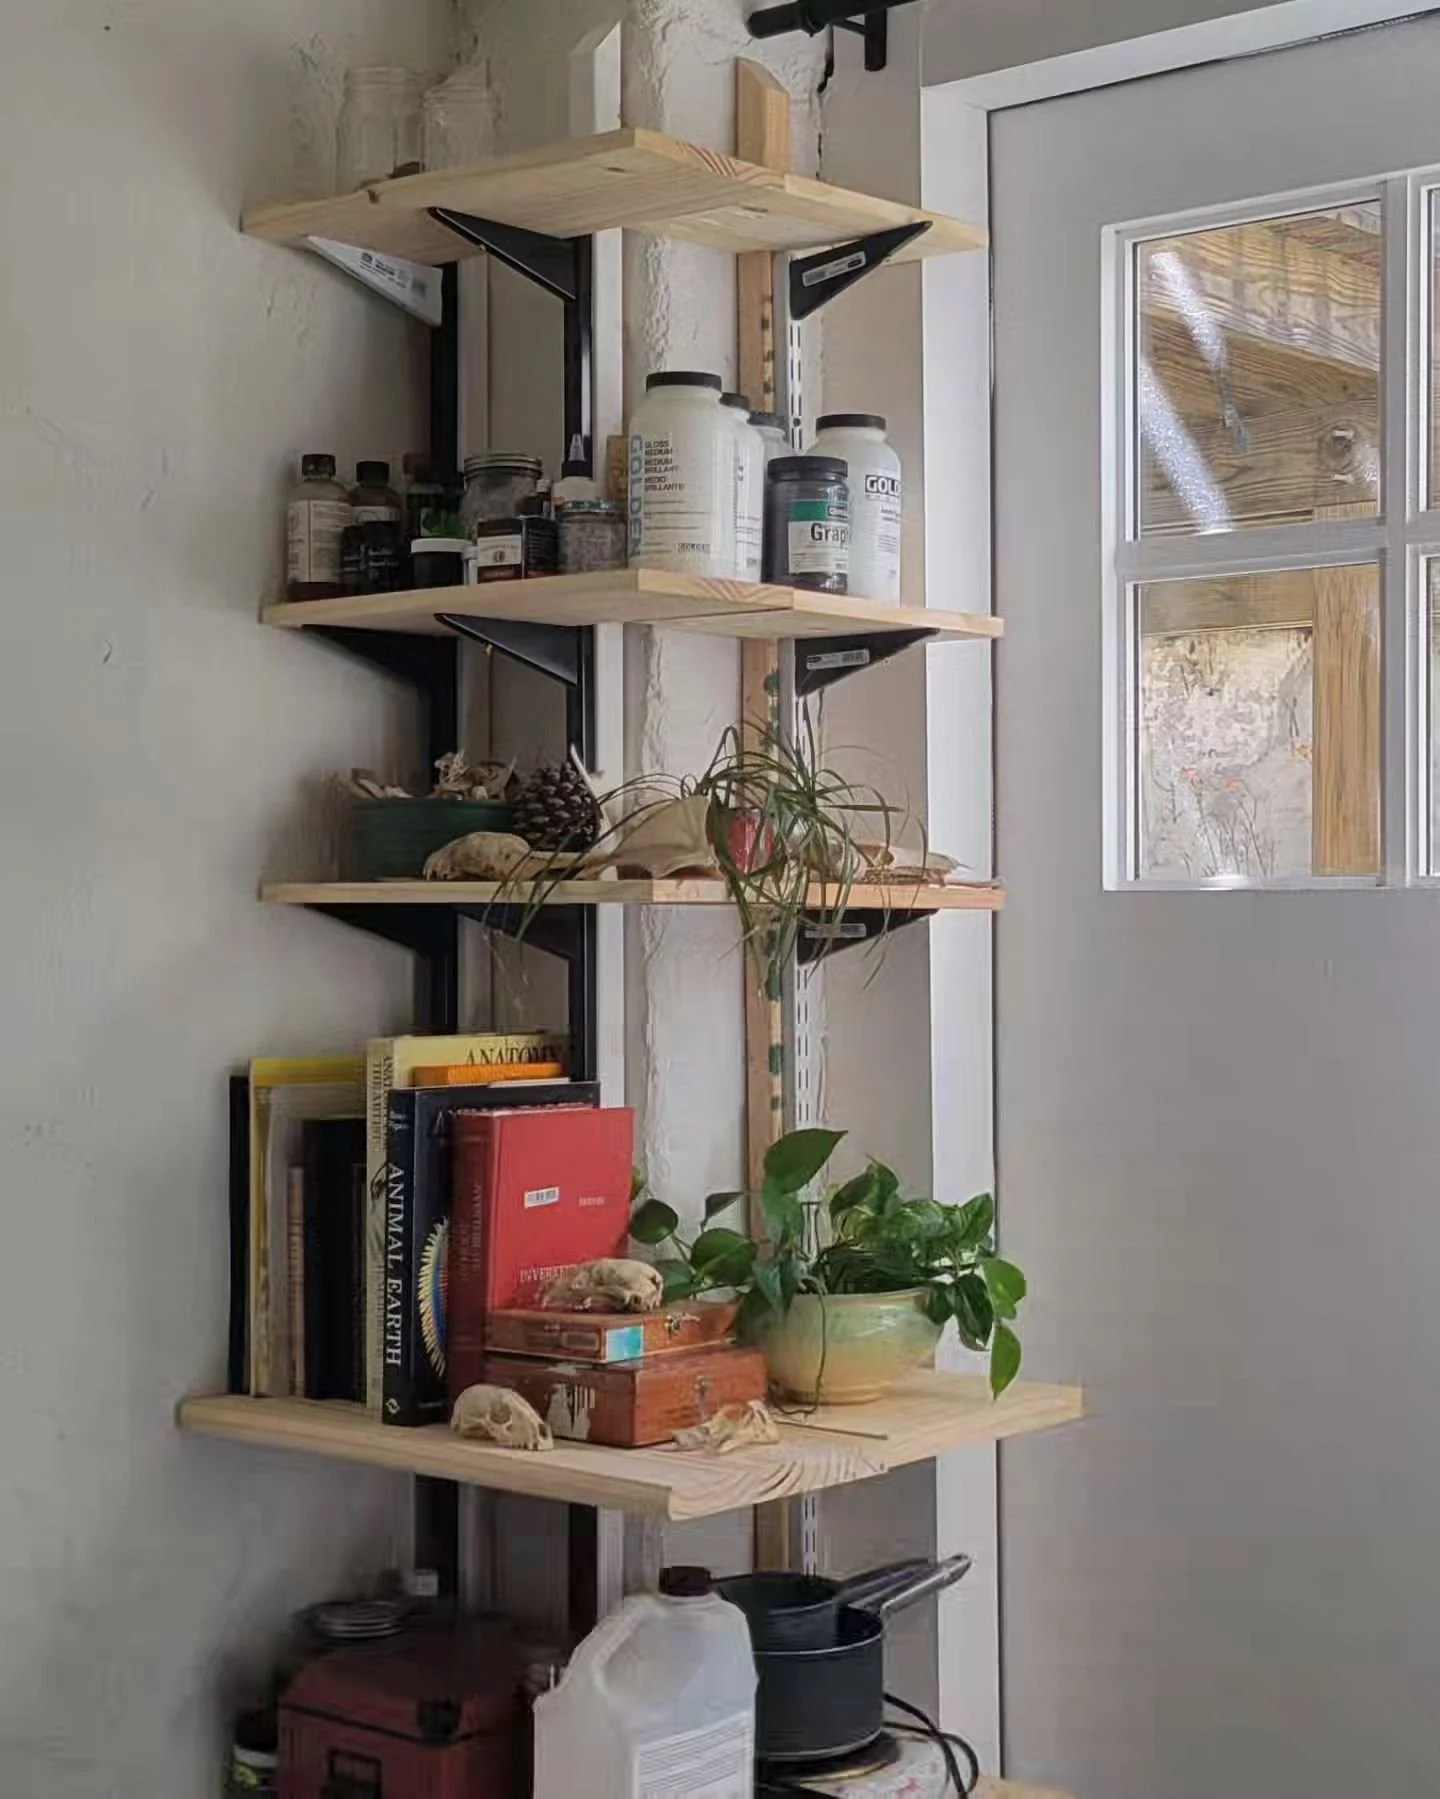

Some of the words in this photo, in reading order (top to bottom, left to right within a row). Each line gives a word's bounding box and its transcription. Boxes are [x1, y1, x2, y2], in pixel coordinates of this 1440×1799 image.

[644, 440, 669, 448] GLOSS
[644, 448, 673, 456] MEDIUM
[630, 435, 643, 557] GOLDEN
[386, 1163, 405, 1270] ANIMAL
[386, 1278, 403, 1367] EARTH
